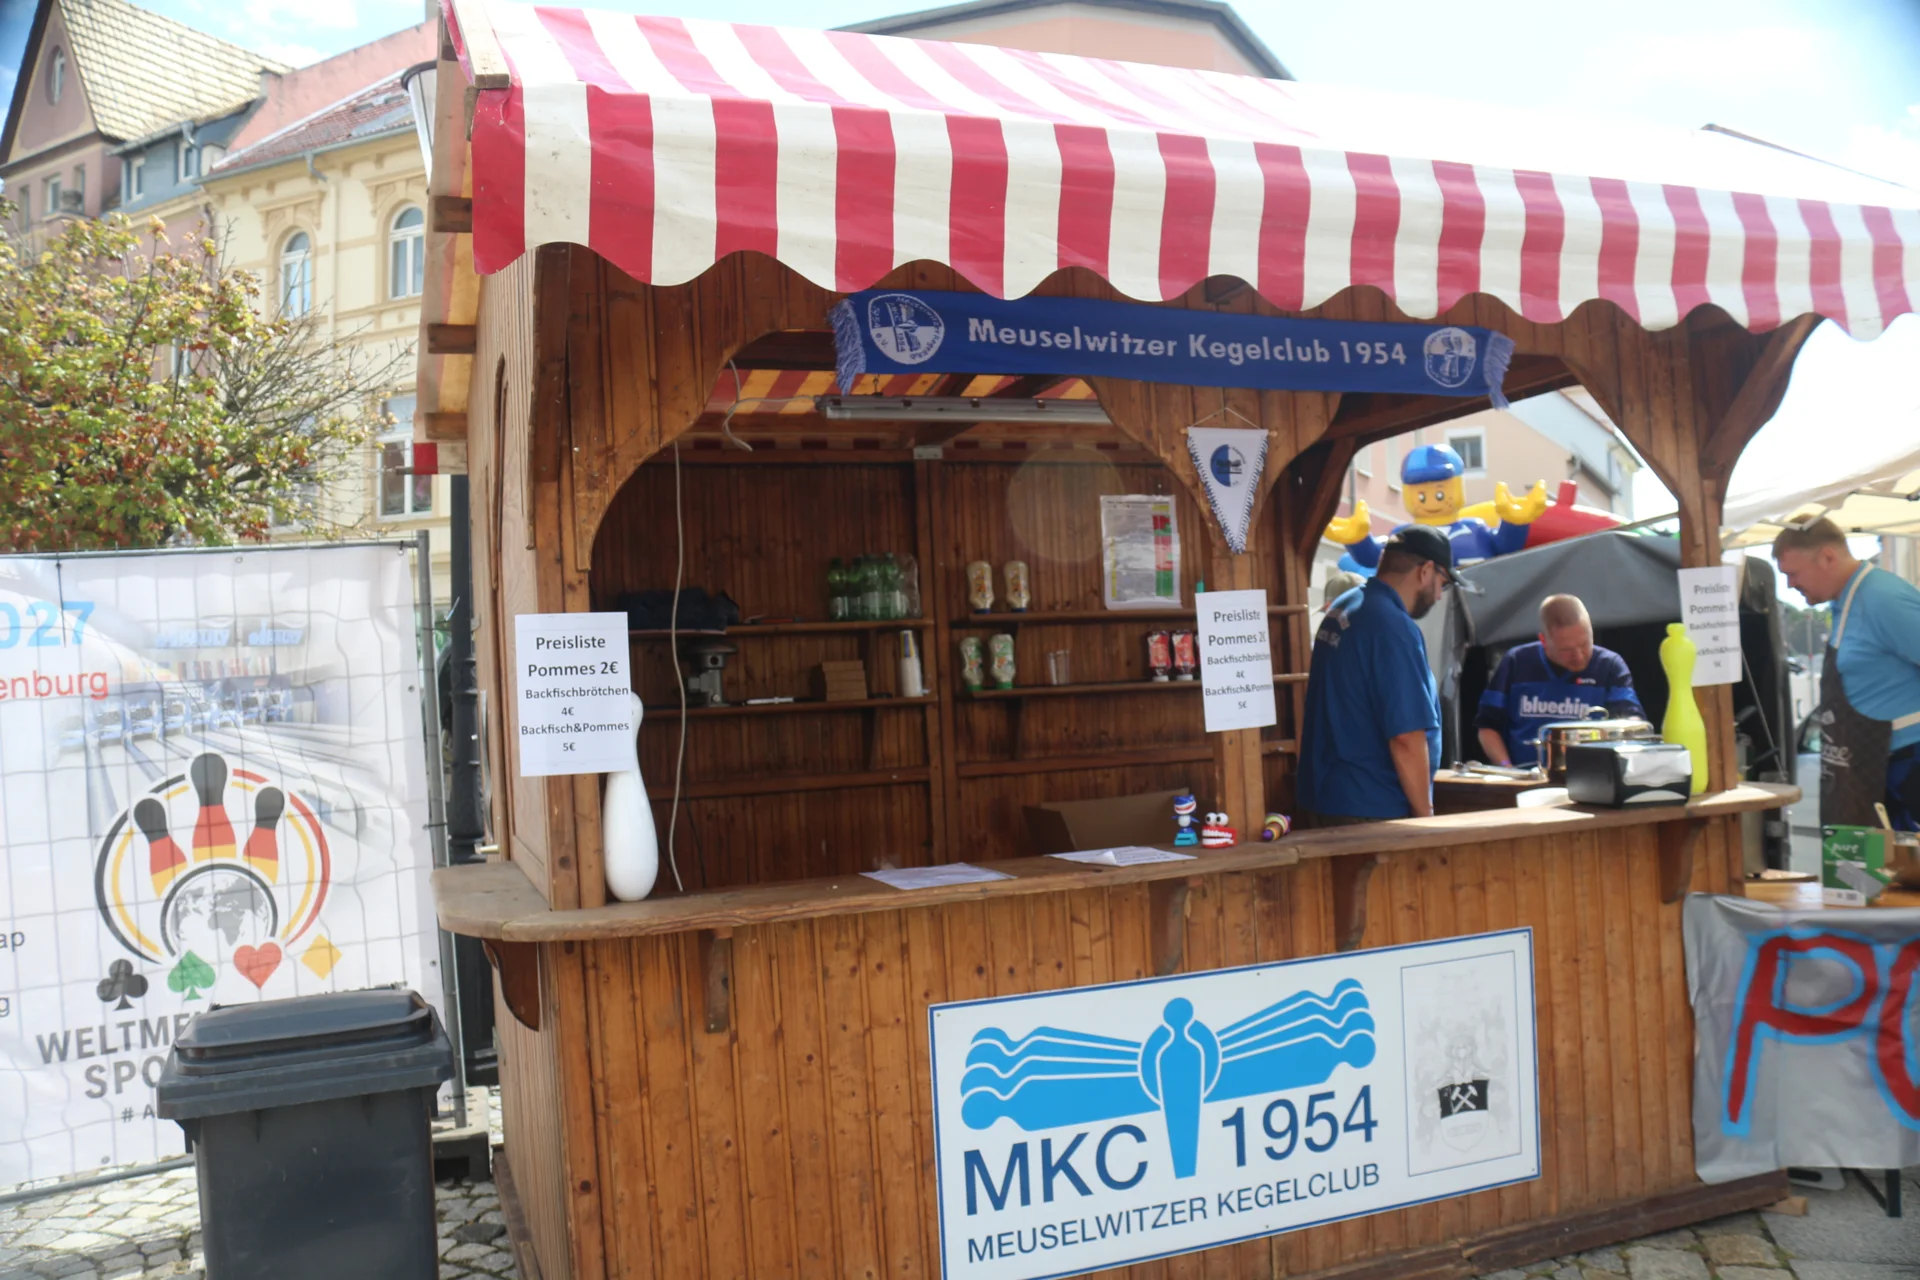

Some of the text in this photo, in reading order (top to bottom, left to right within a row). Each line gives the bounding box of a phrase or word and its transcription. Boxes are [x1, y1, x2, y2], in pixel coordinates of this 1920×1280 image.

[968, 317, 1177, 357] Meuselwitzer
[1189, 334, 1331, 366] Kegelclub
[1340, 341, 1408, 365] 1954
[1213, 609, 1261, 623] Preisliste
[535, 635, 606, 650] Preisliste
[1208, 633, 1257, 646] Pommes
[1207, 653, 1270, 665] Backfischbrö
[528, 661, 619, 677] Pommes 2€
[1235, 670, 1245, 679] 4€
[525, 685, 629, 699] Backfischbrötchen
[1205, 684, 1273, 697] Backfisch&Po
[561, 707, 575, 716] 4€
[1238, 700, 1248, 710] 5€
[1522, 694, 1591, 719] bluechip
[521, 722, 629, 735] Backfisch&Pommes
[563, 742, 576, 752] 5€
[36, 1011, 201, 1064] WELTME
[964, 1084, 1378, 1216] MKC 1954
[968, 1163, 1380, 1263] MEUSELWITZER KEGELCLUB
